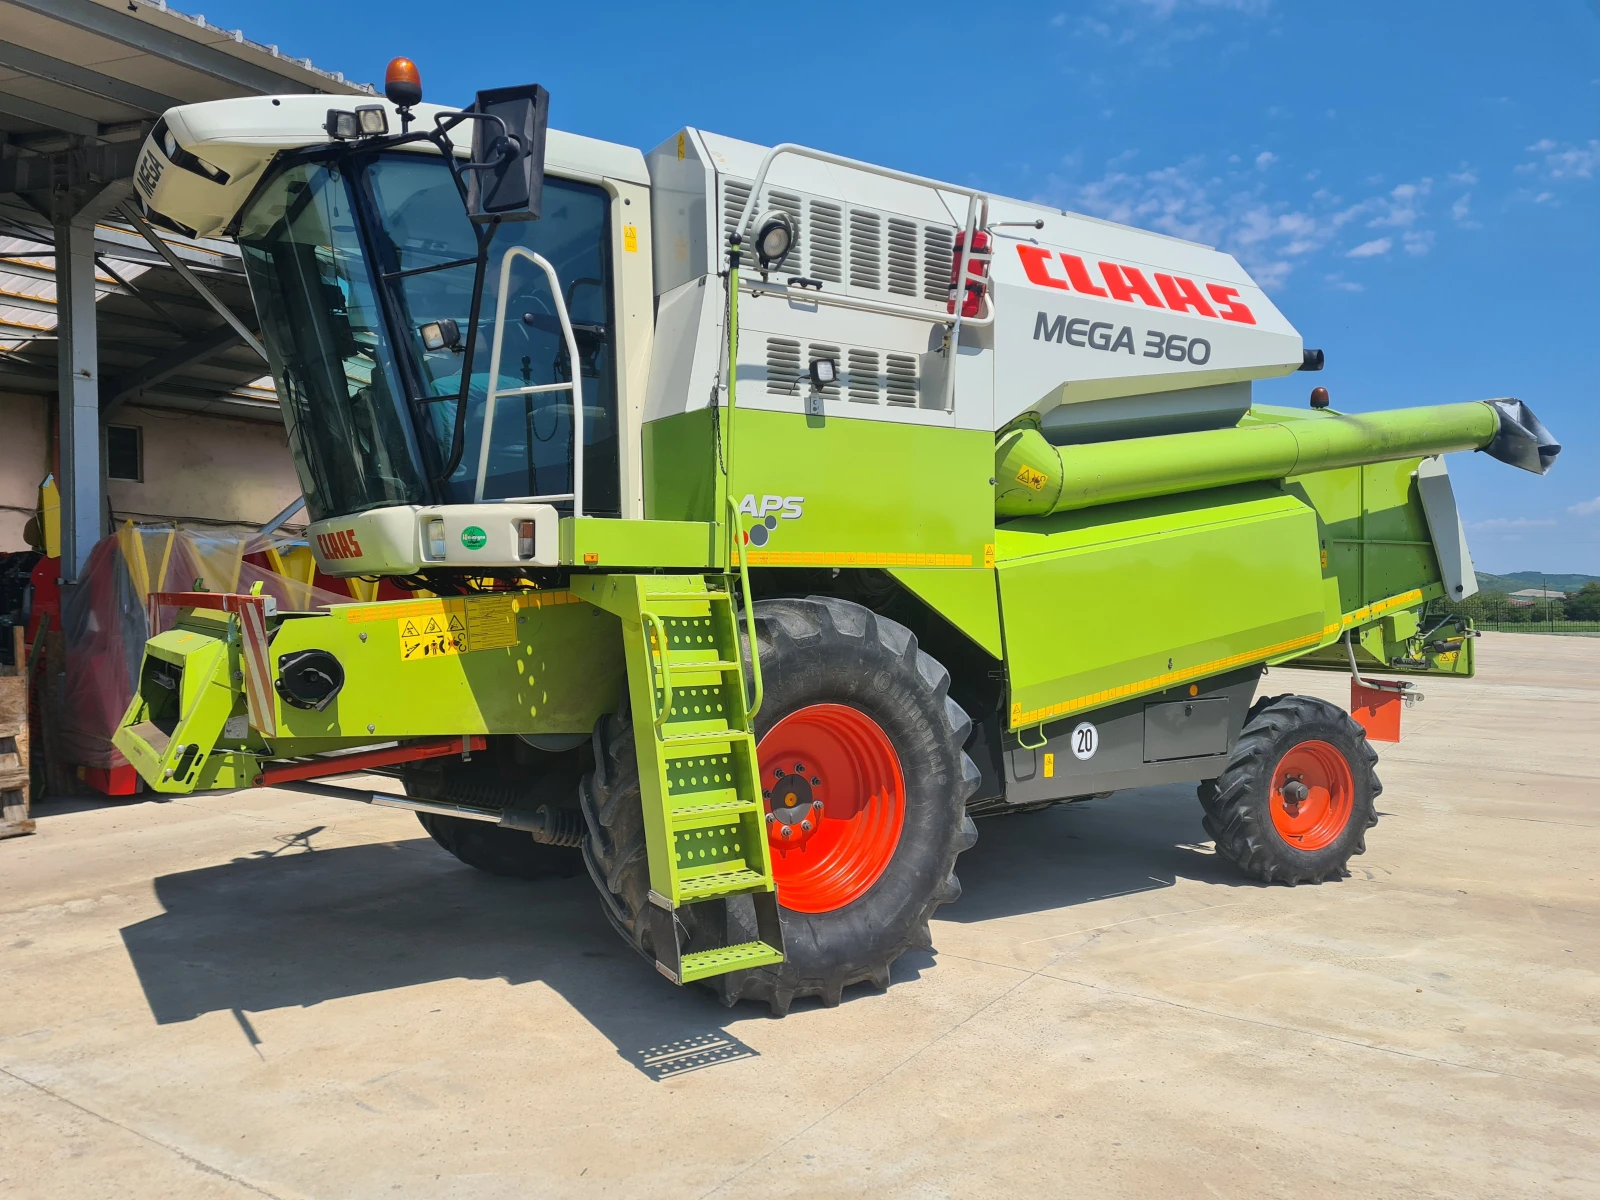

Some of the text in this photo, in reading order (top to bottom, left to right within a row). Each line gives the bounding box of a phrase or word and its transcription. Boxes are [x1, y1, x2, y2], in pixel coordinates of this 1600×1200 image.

[137, 149, 164, 199] MEGA
[1016, 244, 1257, 325] CLAAS
[1033, 311, 1212, 365] MEGA 360
[739, 494, 804, 519] APS
[317, 529, 363, 560] CLAAS
[1077, 728, 1092, 753] 20
